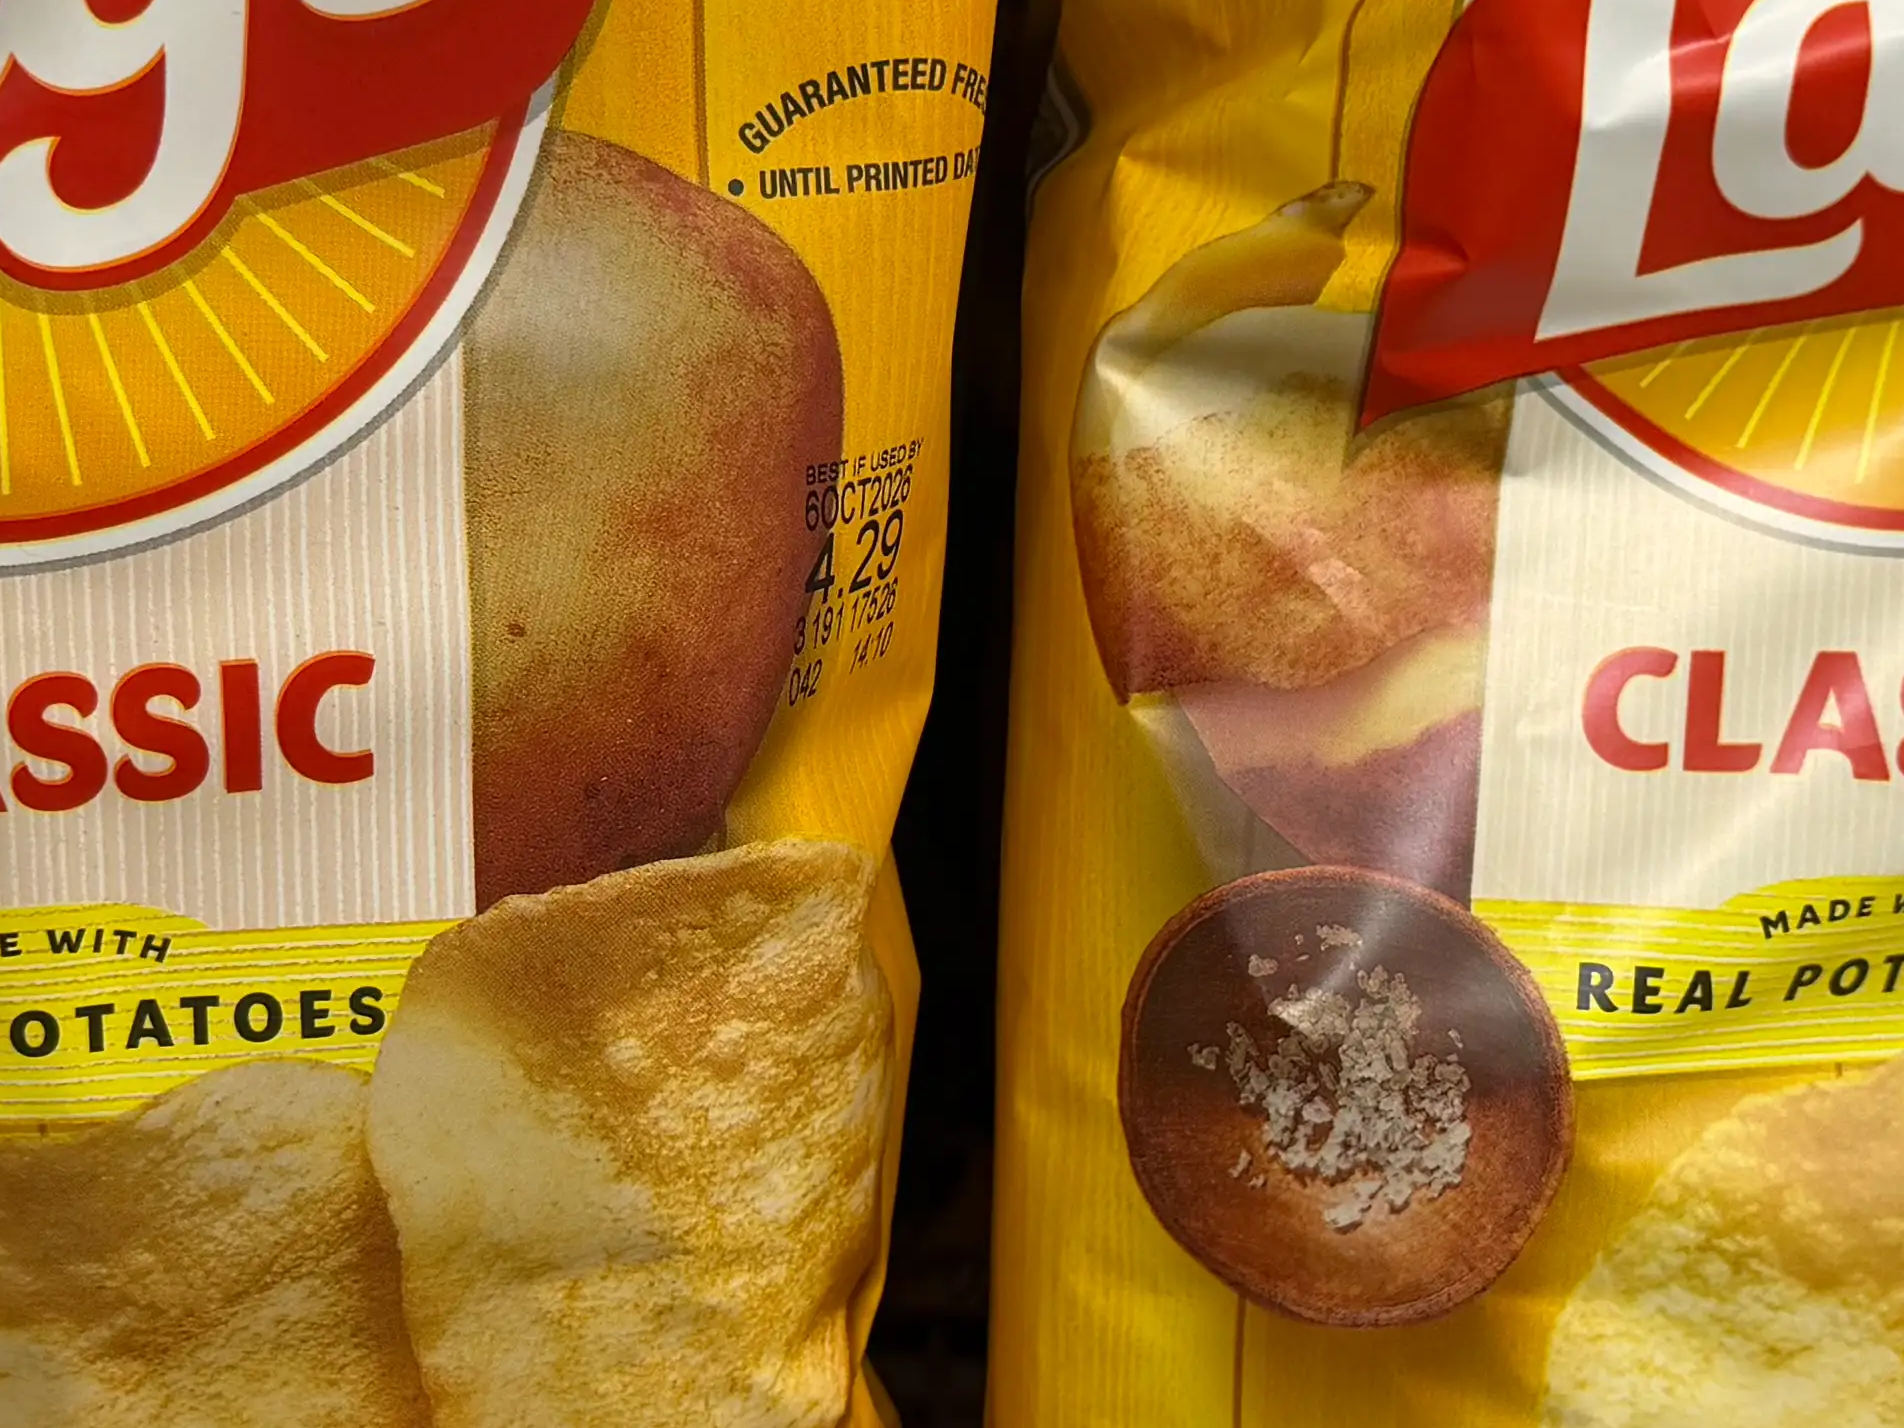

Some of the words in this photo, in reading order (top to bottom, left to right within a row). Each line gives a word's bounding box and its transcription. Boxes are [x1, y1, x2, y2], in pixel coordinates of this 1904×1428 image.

[737, 57, 947, 155] GUARANTEED
[758, 165, 841, 200] UNTIL
[846, 155, 949, 194] PRINTED
[806, 459, 848, 486] BEST
[852, 455, 867, 477] IF
[870, 443, 907, 472] USED
[907, 437, 925, 461] BY
[804, 508, 905, 606] 4.29
[1758, 893, 1875, 939] MADE
[46, 926, 174, 963] WITH
[1575, 960, 1754, 1017] REAL
